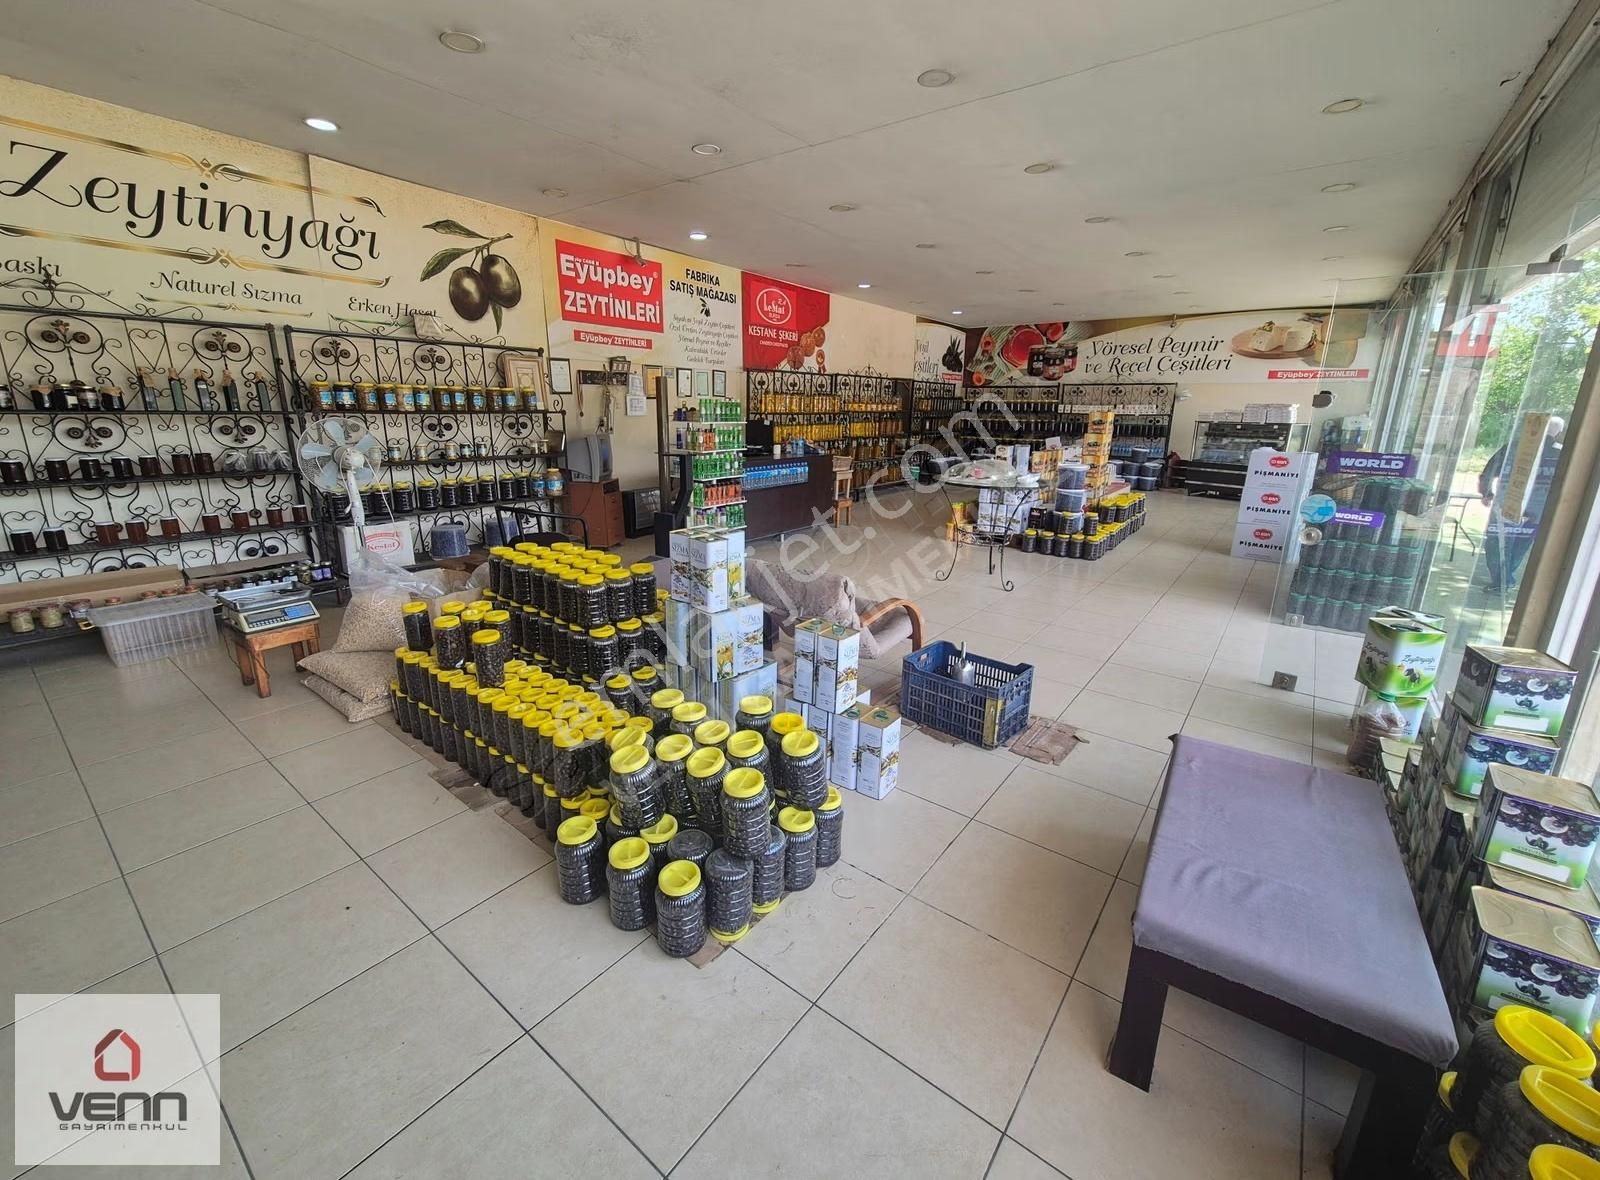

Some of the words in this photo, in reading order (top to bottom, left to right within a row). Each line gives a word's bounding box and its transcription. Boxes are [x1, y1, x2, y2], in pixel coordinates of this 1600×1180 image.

[0, 140, 380, 272] Zeytinyağı
[0, 256, 62, 277] askı
[560, 253, 654, 295] Eyüpbey
[686, 268, 720, 286] FABRİKA
[150, 270, 236, 298] Naturel
[242, 283, 302, 305] Sızma
[670, 279, 694, 298] SATIŞ
[697, 286, 736, 304] MAĞAZASI
[348, 297, 392, 314] Erken
[564, 290, 660, 324] ZEYTİNLERİ
[580, 332, 612, 345] Eyüpbey
[614, 336, 647, 347] ZEYTİNLERİ
[748, 325, 777, 339] KESTANE
[778, 330, 798, 342] ŞEKERİ
[1086, 338, 1153, 359] Yöresel
[1158, 335, 1224, 358] Peynir
[1085, 362, 1103, 374] ve
[1109, 356, 1153, 377] Reçel
[1157, 354, 1233, 375] Çeşitleri
[1277, 371, 1314, 380] Eyüpbey
[1339, 457, 1404, 470] WORLD
[1246, 506, 1291, 515] PİŞMANİYE
[1335, 512, 1373, 522] WORLD
[1239, 541, 1283, 551] PİŞMANİYE
